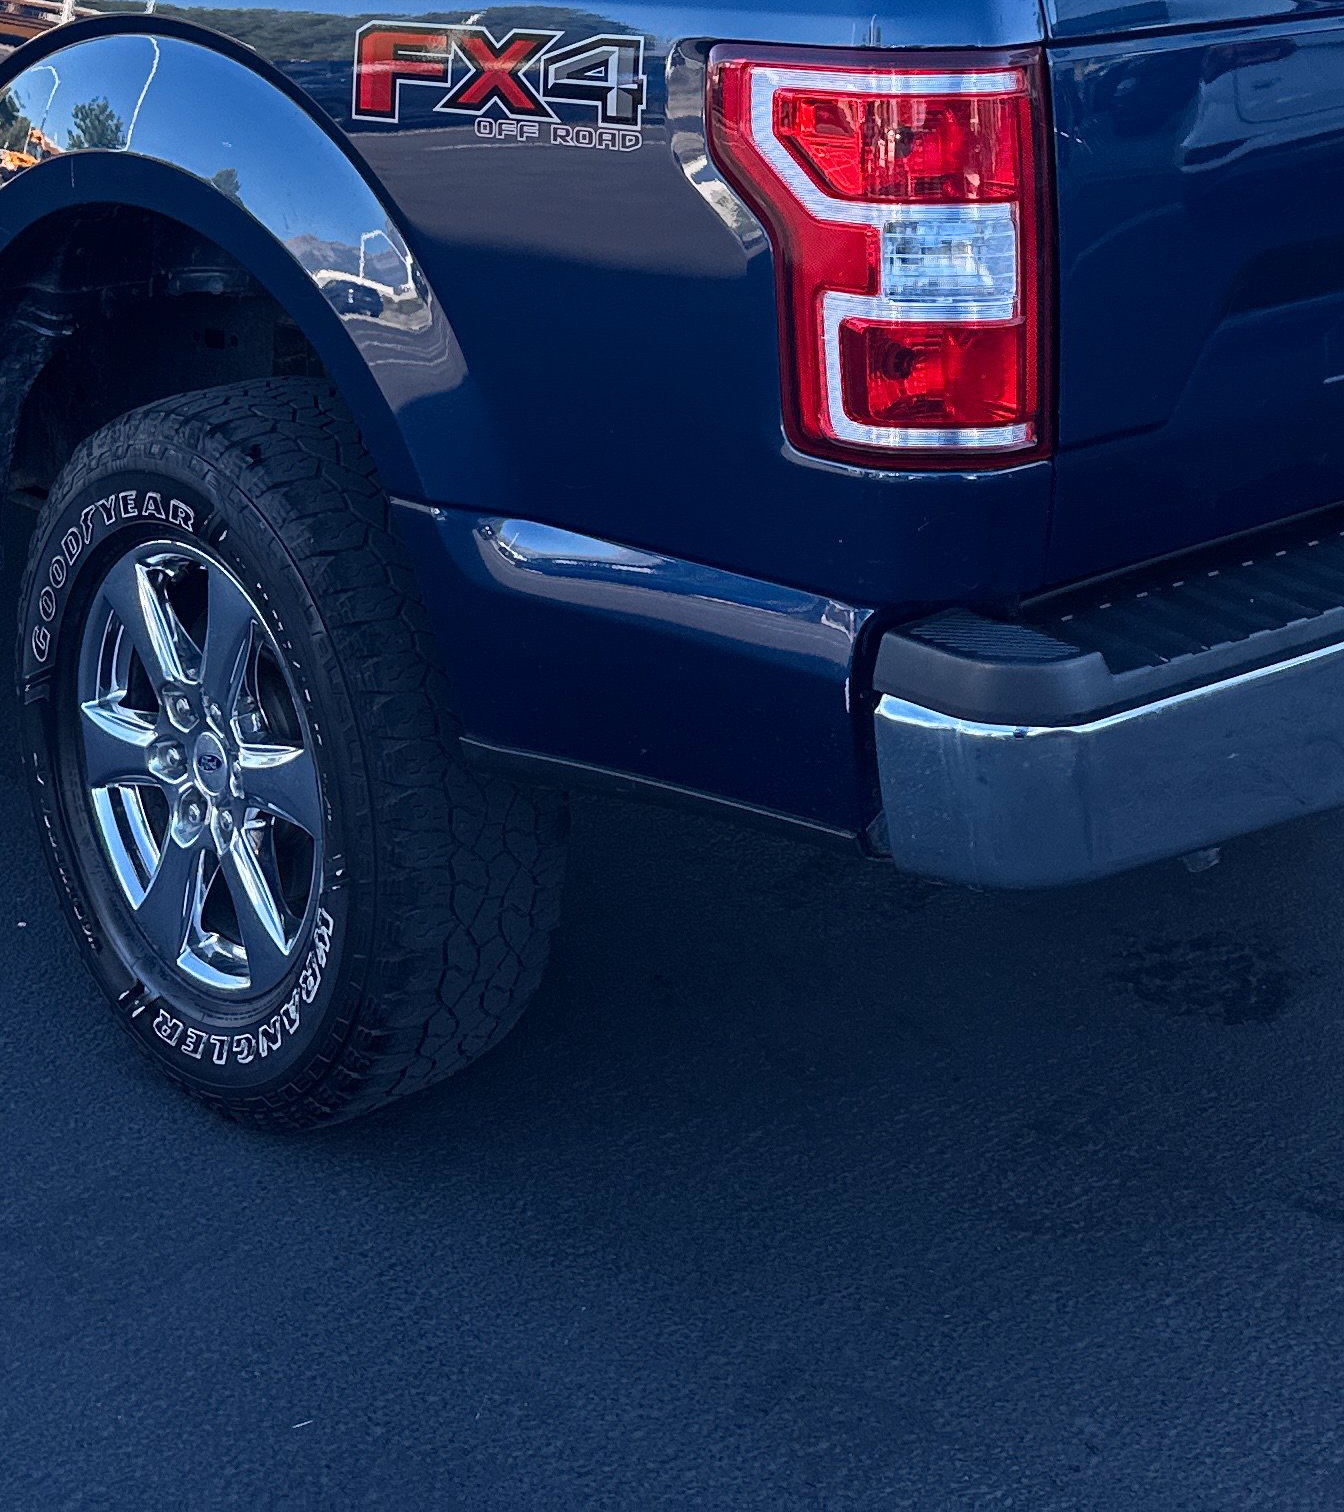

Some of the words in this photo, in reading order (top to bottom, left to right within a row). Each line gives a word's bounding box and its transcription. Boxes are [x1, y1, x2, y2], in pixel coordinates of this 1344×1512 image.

[352, 19, 647, 131] FX4
[474, 117, 539, 141] OFF
[550, 124, 643, 152] ROAD
[31, 490, 195, 663] GOODYEAR
[152, 907, 334, 1065] WRANGLER
